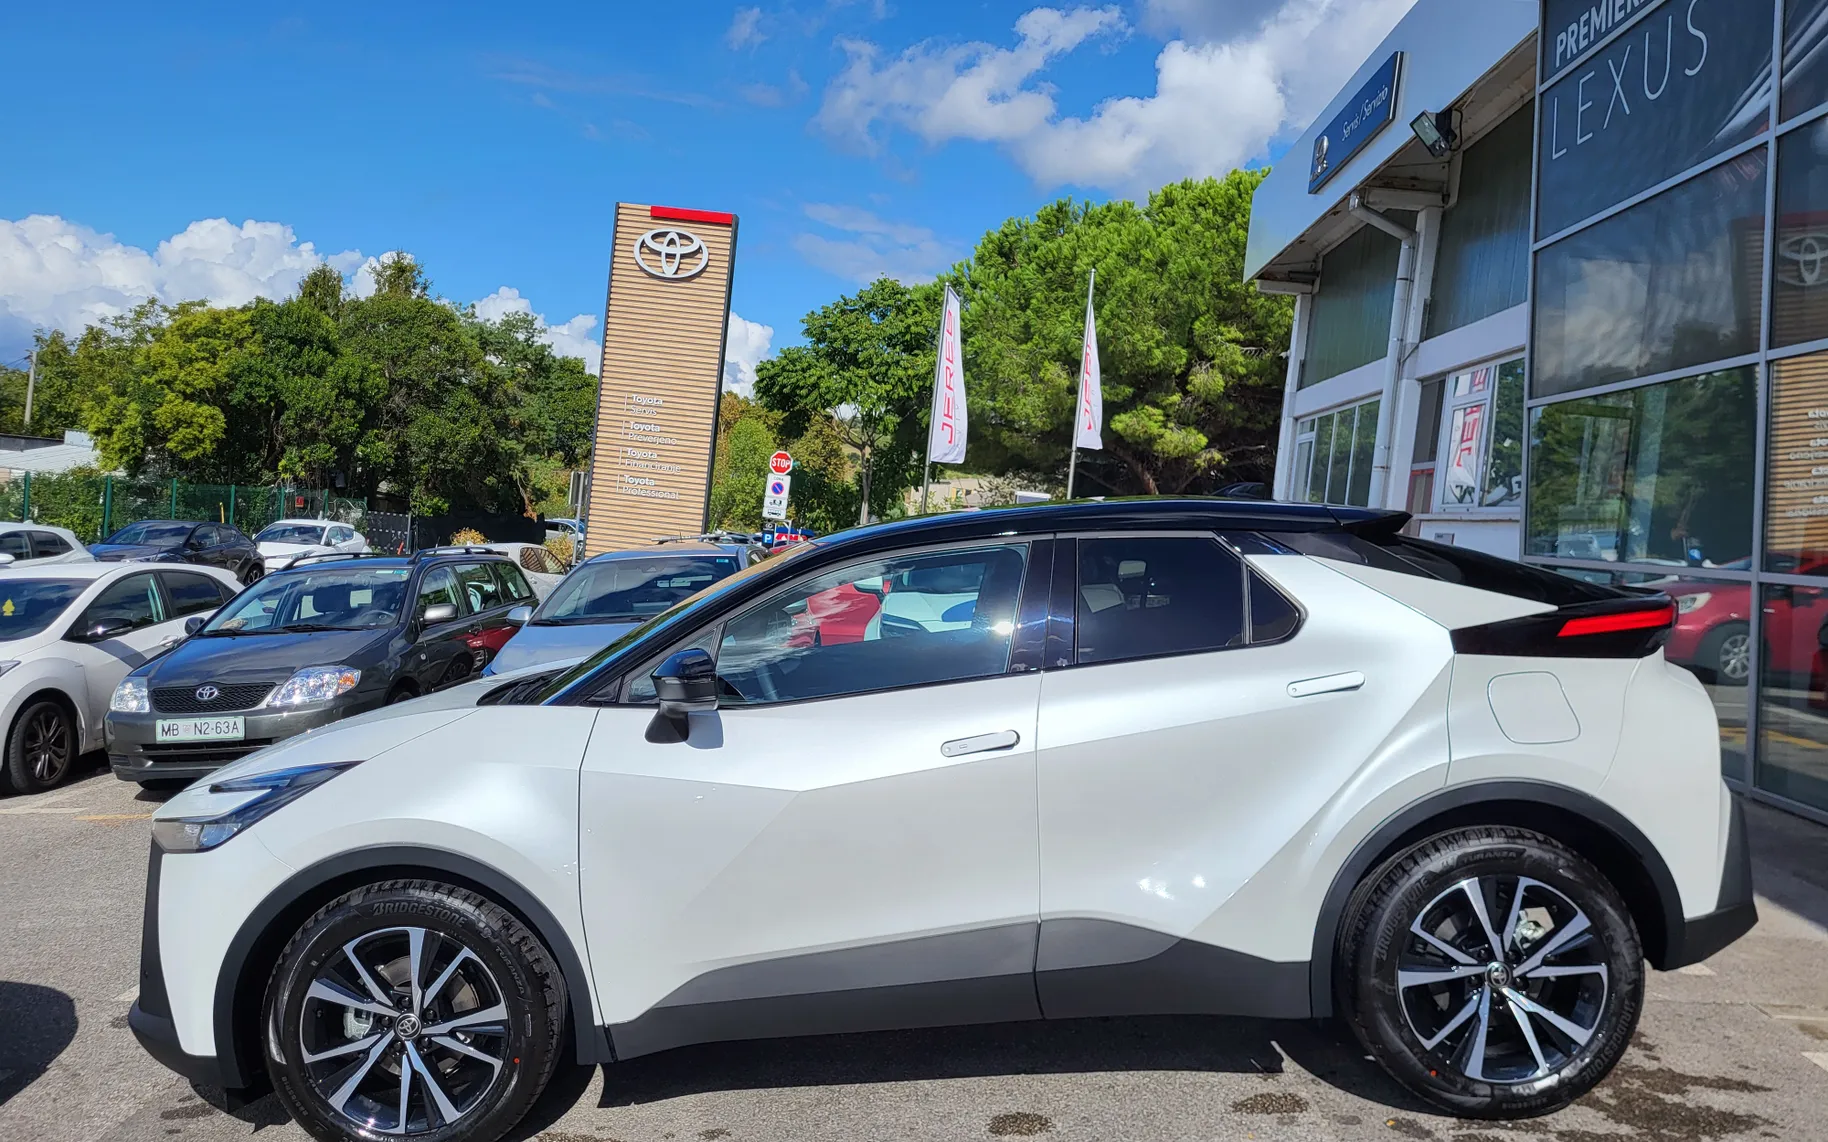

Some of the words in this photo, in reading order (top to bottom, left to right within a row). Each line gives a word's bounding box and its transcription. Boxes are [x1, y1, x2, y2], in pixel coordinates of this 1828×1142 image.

[1552, 0, 1708, 160] LEXUS
[1341, 113, 1360, 141] Servis
[1362, 84, 1389, 120] Servizio
[631, 394, 663, 405] Toyota
[630, 405, 657, 416] Servis
[629, 421, 660, 432] Toyota
[628, 432, 677, 445] Preverjeno
[627, 448, 657, 459] Toyota
[771, 457, 791, 469] STOP
[623, 474, 655, 486] Toyota
[622, 486, 680, 499] Professional
[764, 533, 772, 543] P
[161, 723, 179, 737] MB
[194, 720, 240, 735] N2-63A
[372, 901, 469, 928] BRIDGESTONE
[495, 945, 526, 996] TURANZA
